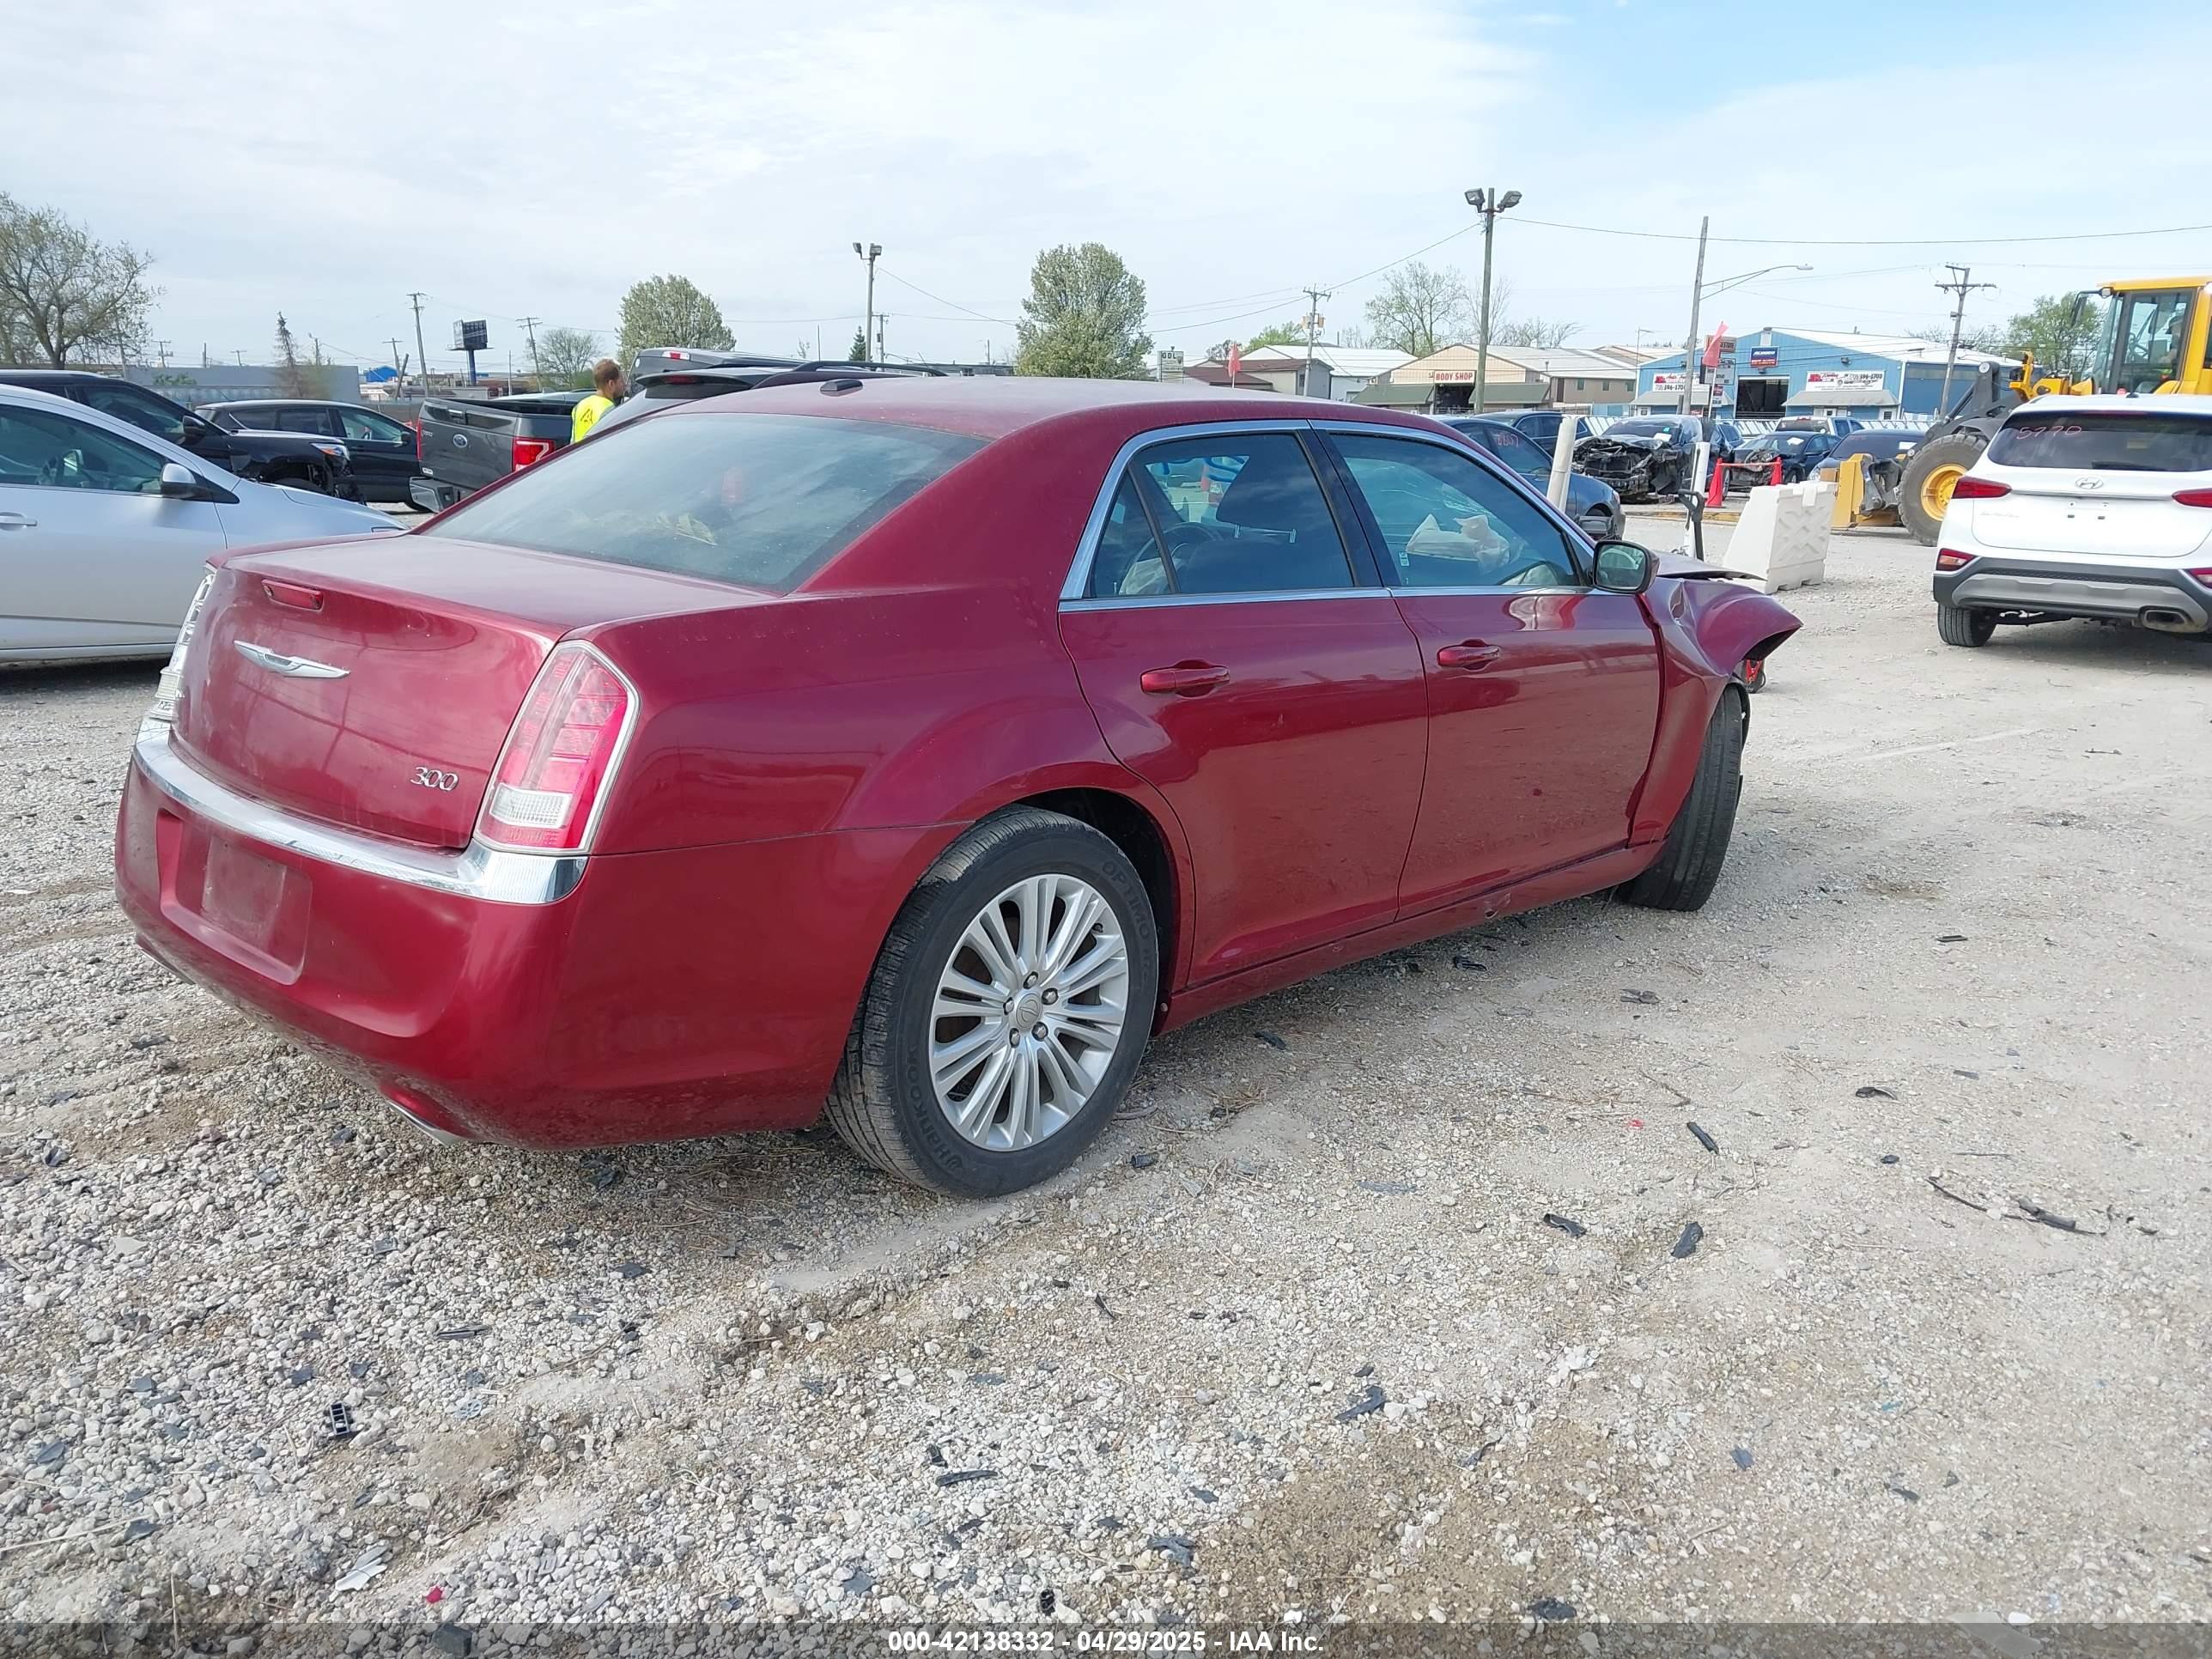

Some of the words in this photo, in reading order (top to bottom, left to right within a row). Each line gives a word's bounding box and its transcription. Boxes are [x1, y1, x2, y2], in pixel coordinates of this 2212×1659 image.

[1436, 373, 1453, 381] BODY
[1455, 372, 1474, 381] SHOP
[410, 766, 459, 791] 300
